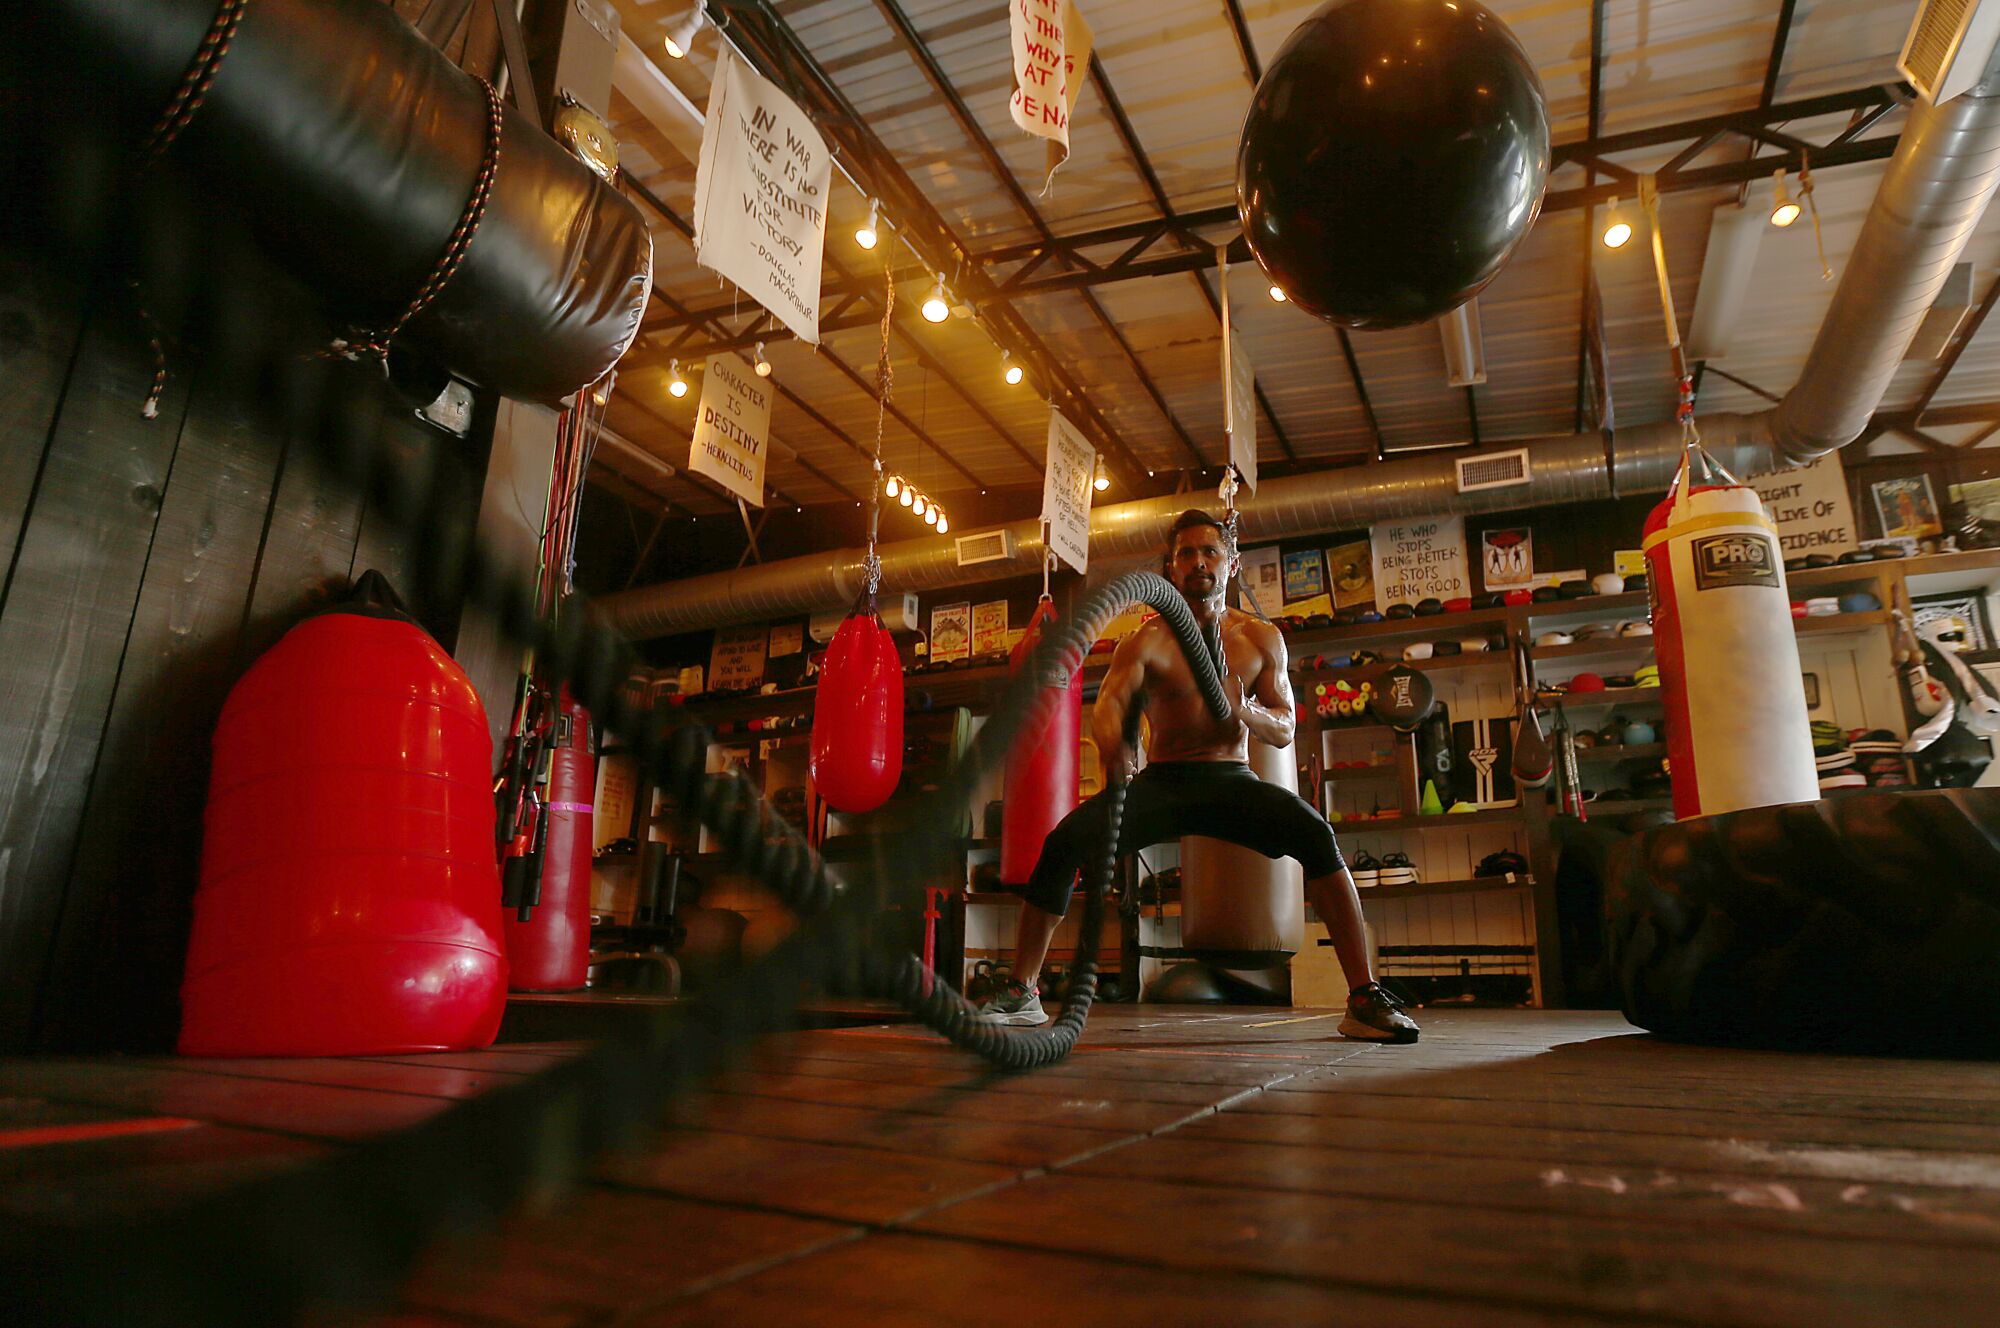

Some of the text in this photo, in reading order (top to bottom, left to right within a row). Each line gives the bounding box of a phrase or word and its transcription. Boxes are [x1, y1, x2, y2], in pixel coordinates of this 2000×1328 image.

[1023, 31, 1060, 67] WHY
[1024, 62, 1053, 86] AT
[751, 105, 811, 173] IN WAR
[739, 111, 818, 196] THERE IS NO
[747, 151, 822, 230] SUBSTITUTE
[757, 188, 784, 226] FOR
[768, 271, 813, 321] MACARTHUR
[713, 361, 765, 411] CHARACTER
[727, 393, 742, 417] IS
[704, 406, 760, 455] DESTINY
[1773, 500, 1835, 522] LIVE OF
[1389, 524, 1438, 541] HE WHO
[1780, 528, 1848, 550] FIDENCE
[1382, 547, 1459, 569] BEING BETTER
[1397, 538, 1432, 554] STOPS
[1712, 543, 1764, 564] PRO
[1400, 565, 1439, 580] STOPS
[1386, 578, 1461, 599] BEING GOOD
[720, 664, 752, 675] YOU WILL
